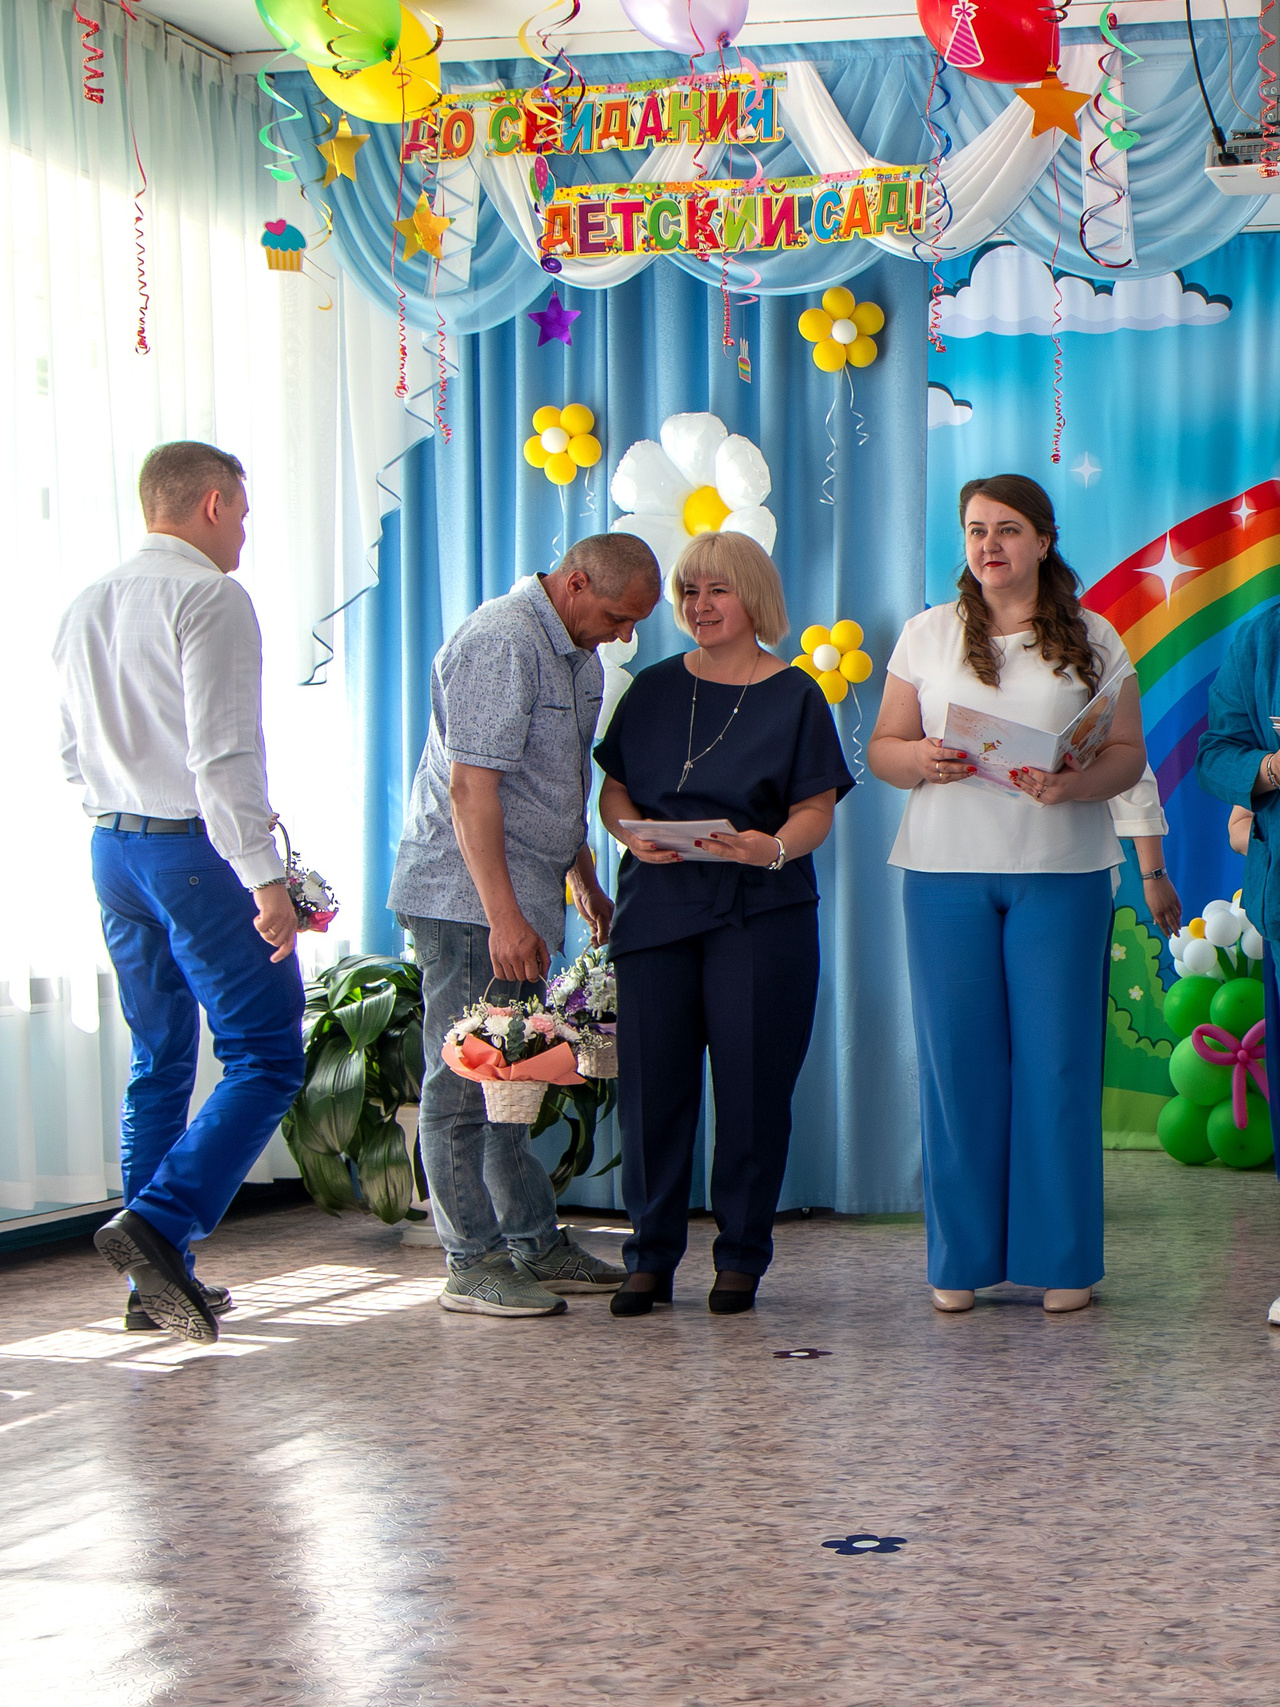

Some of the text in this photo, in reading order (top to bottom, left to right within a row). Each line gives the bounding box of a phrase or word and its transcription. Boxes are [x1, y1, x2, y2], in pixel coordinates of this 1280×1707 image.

[400, 108, 476, 163] ДО
[541, 180, 928, 258] ДЕТСКИЙ САД!
